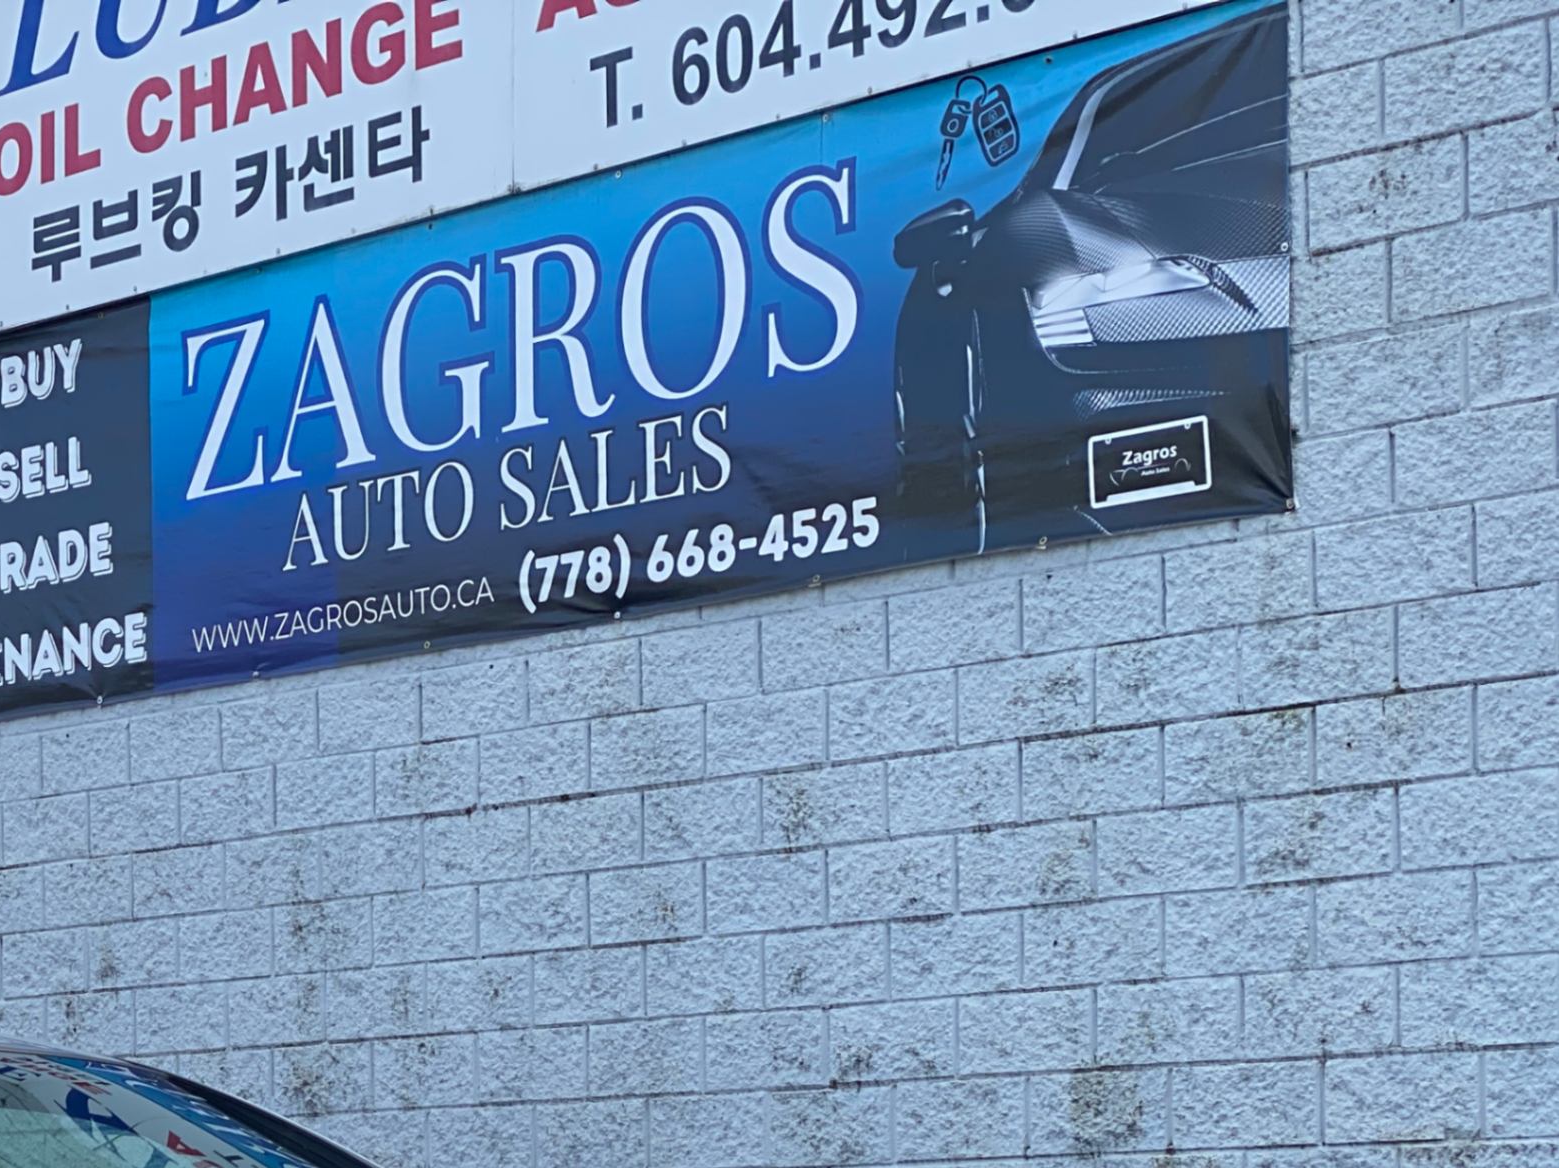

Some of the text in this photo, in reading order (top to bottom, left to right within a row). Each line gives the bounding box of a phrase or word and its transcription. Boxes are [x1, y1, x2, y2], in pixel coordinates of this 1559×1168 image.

[126, 0, 463, 154] CHANGE
[590, 0, 1036, 129] T. 604.492.
[31, 105, 430, 282] 루브킹 카센타
[0, 338, 83, 408] BUY
[184, 164, 861, 501] ZAGROS
[282, 403, 731, 572] AUTO SALES
[1122, 445, 1177, 466] Zagros
[191, 576, 495, 653] WWW.ZAGROSAUTO.CA
[519, 497, 881, 614] (778) 668-4525
